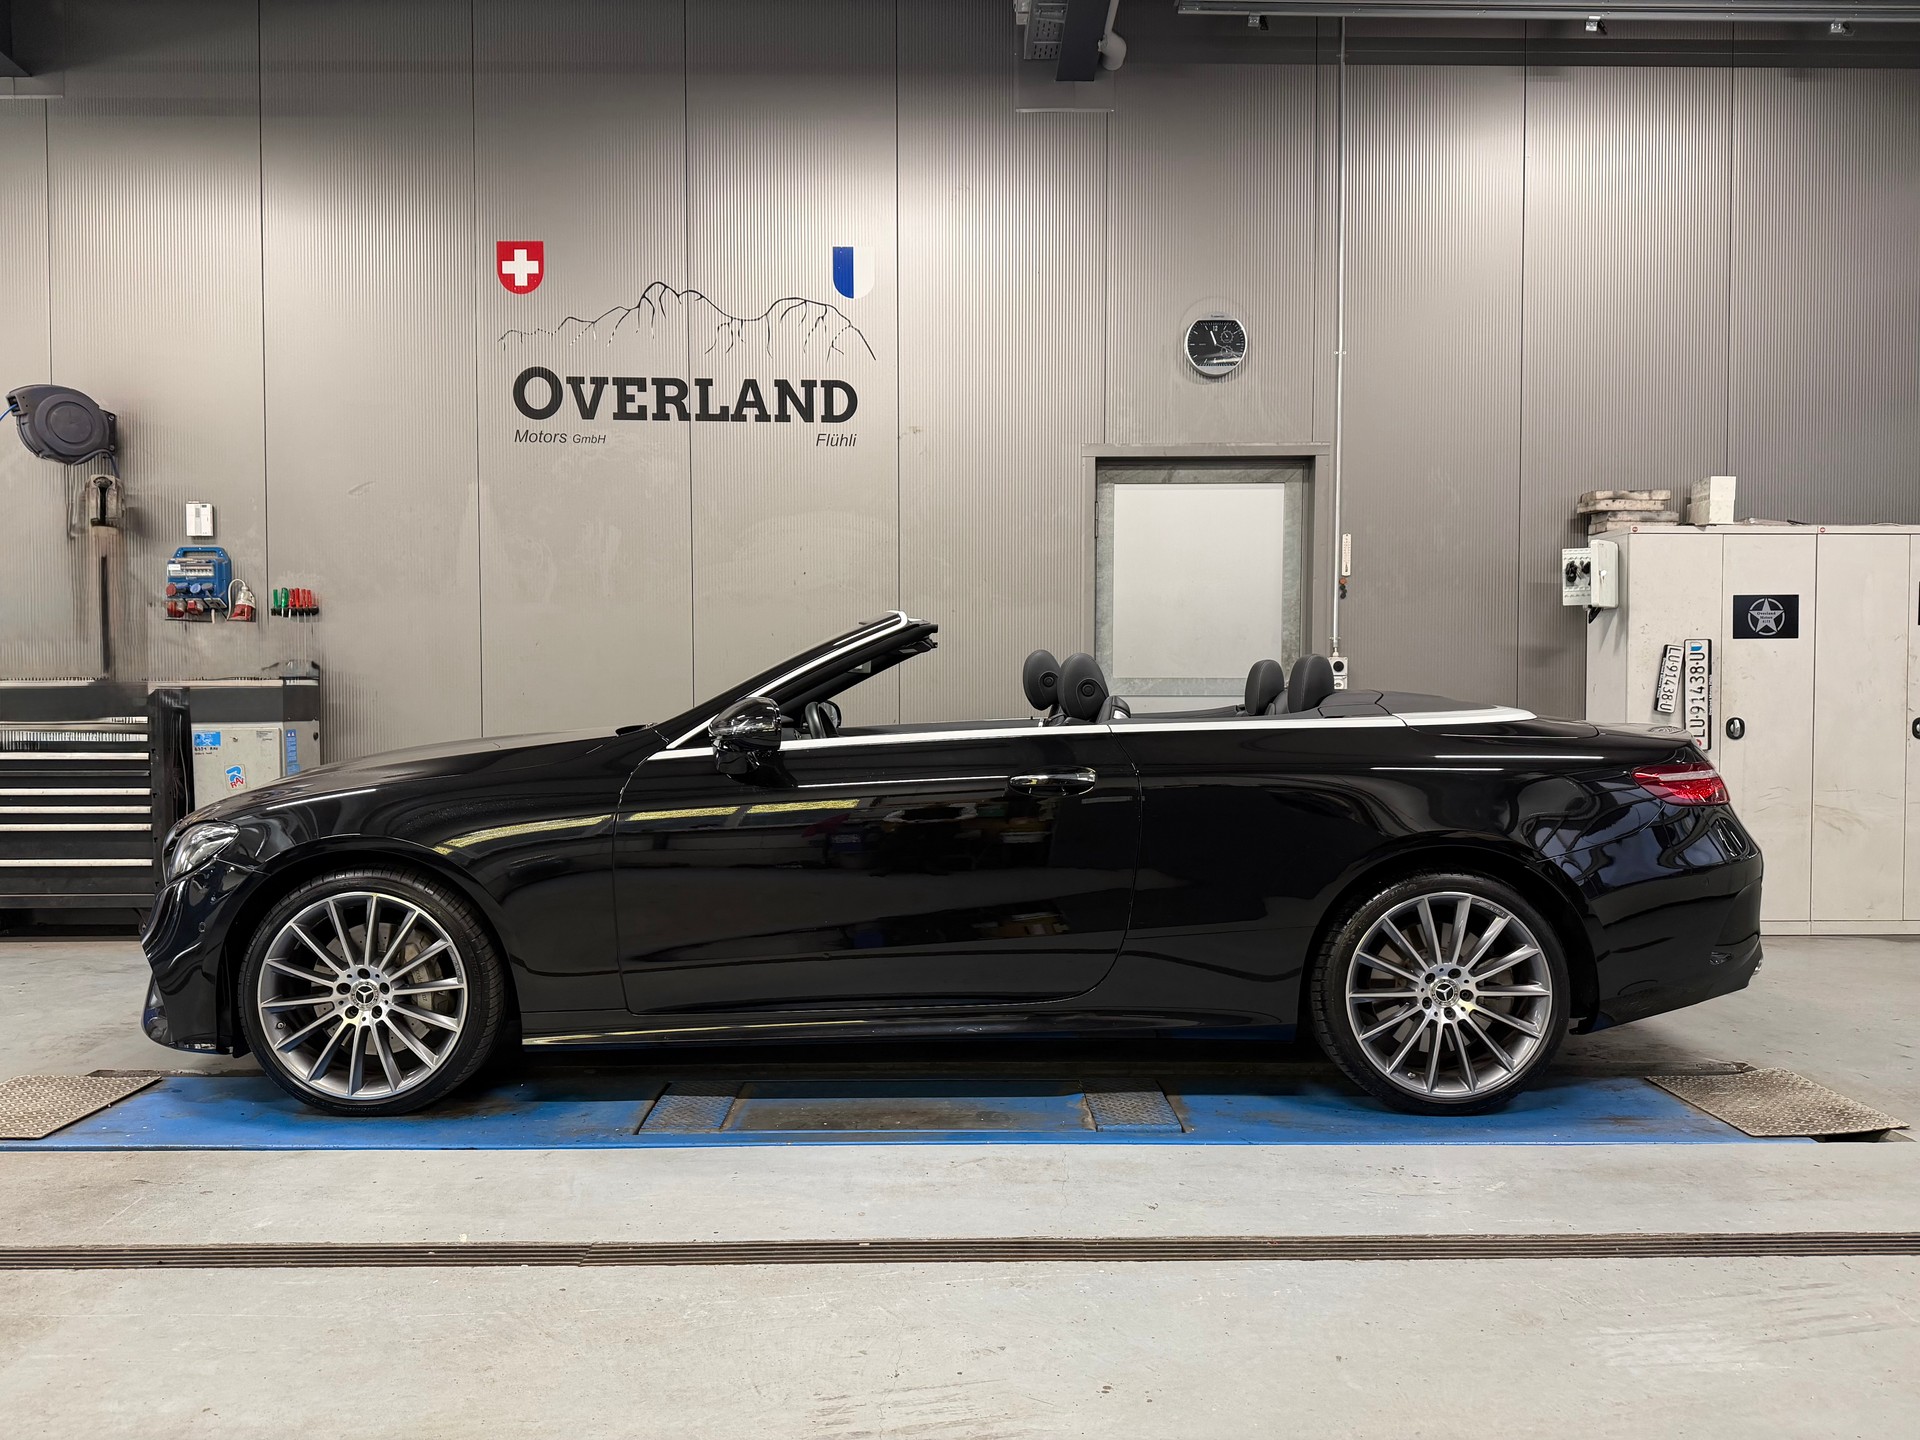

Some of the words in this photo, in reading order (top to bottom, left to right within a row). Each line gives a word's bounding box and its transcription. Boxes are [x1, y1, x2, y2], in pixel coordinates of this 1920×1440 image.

[514, 429, 568, 444] Motors
[572, 434, 606, 444] GmbH
[815, 432, 857, 447] Flühli
[229, 777, 244, 789] RAV
